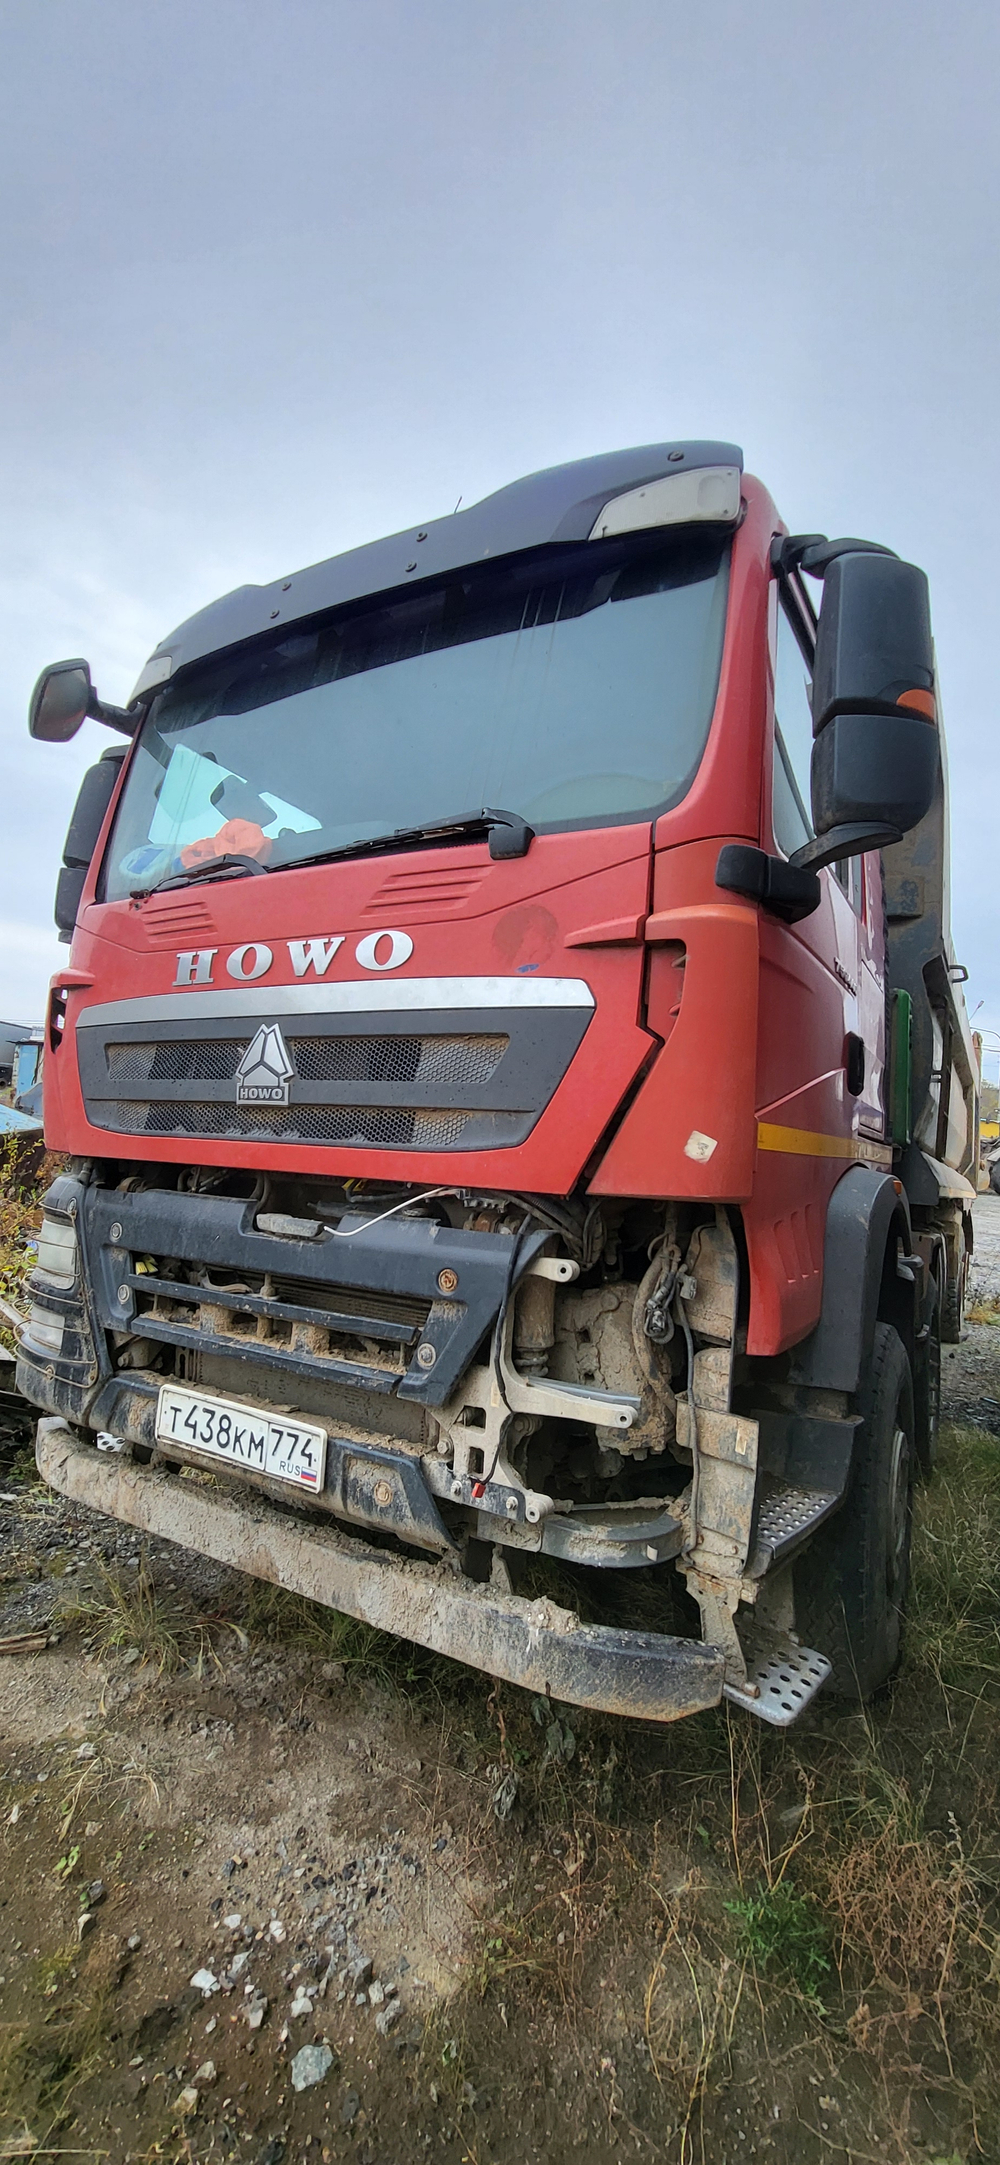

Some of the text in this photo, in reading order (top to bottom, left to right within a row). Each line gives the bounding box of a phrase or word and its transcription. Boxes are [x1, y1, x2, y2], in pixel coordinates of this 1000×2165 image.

[172, 930, 413, 987] HOWO
[240, 1088, 283, 1100] HOWO
[279, 1461, 301, 1476] RUS
